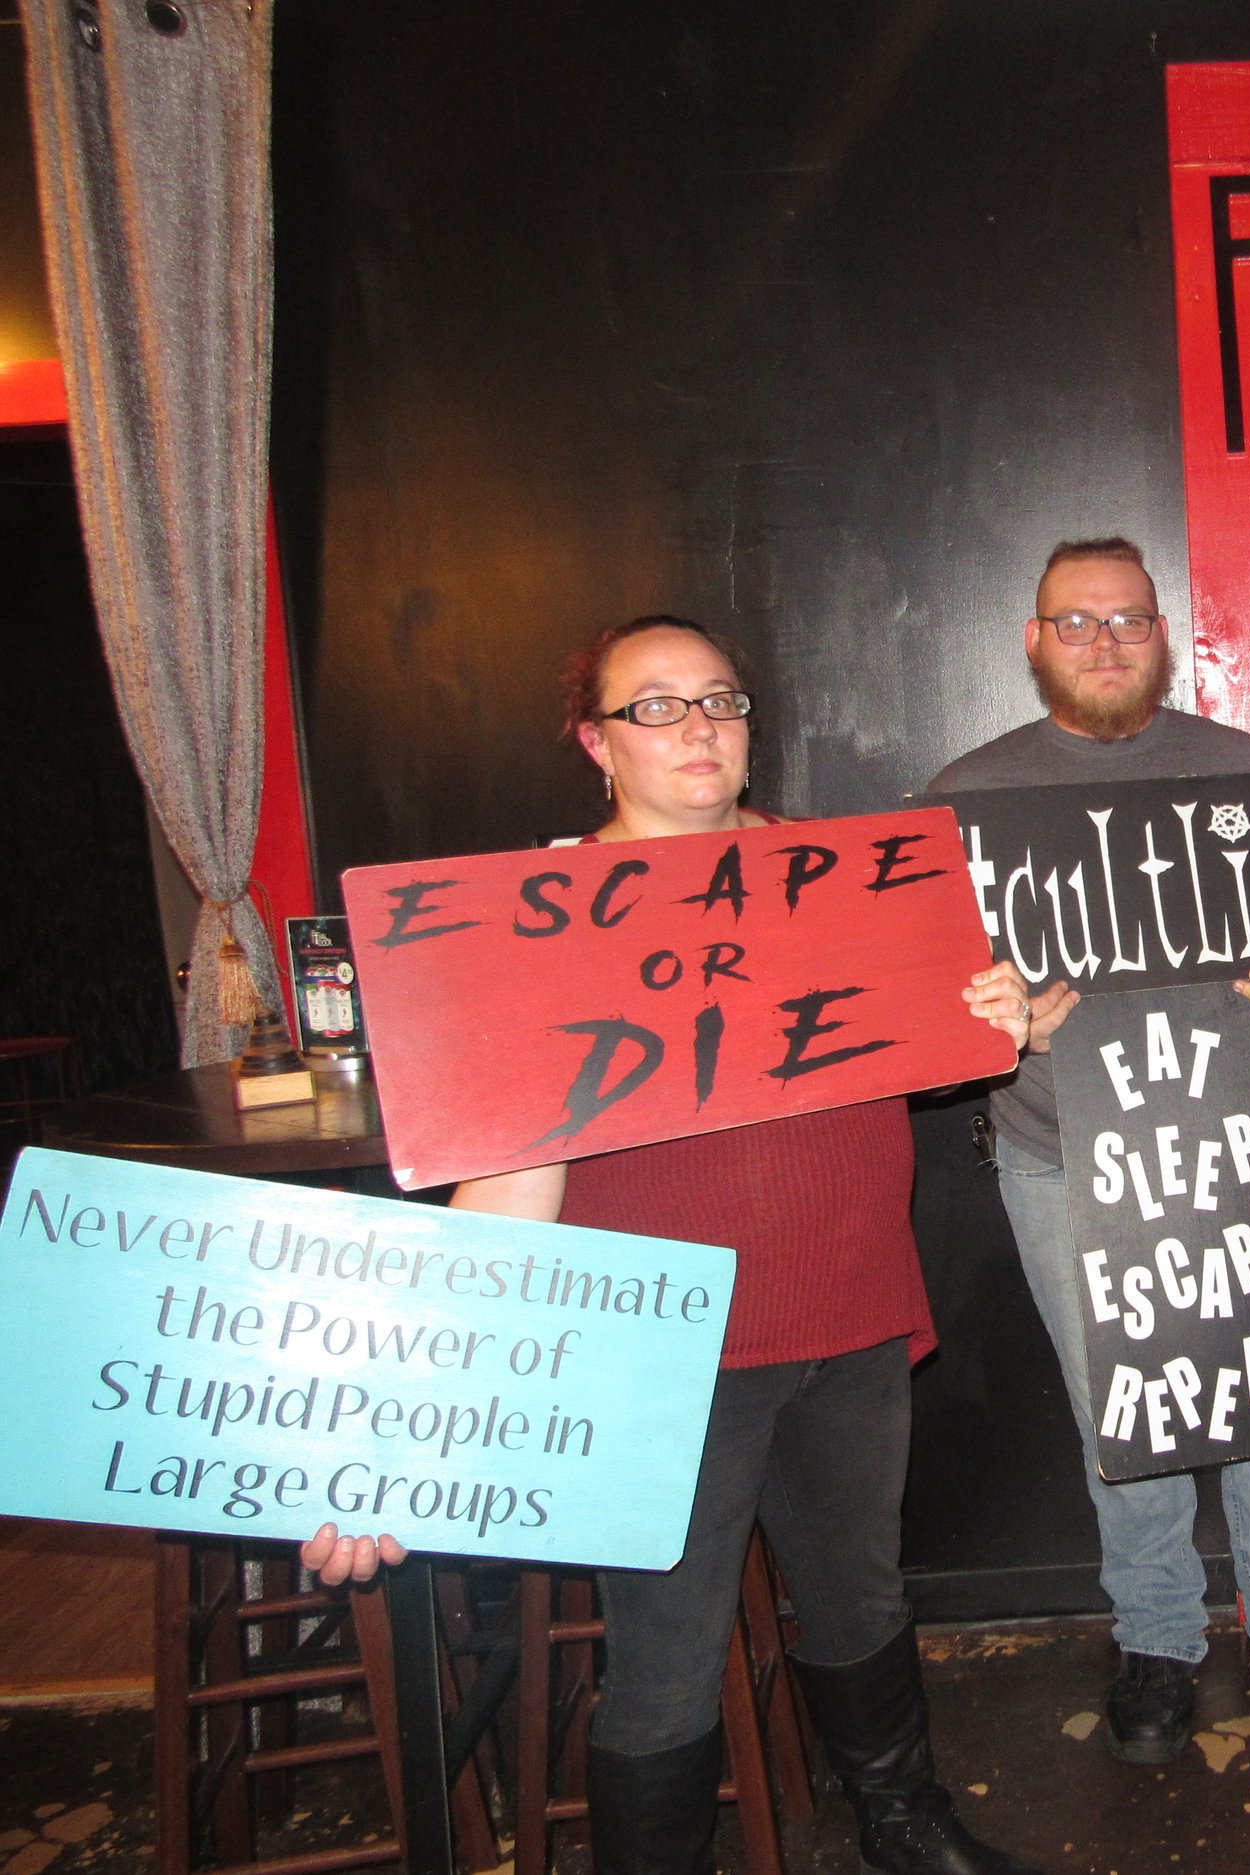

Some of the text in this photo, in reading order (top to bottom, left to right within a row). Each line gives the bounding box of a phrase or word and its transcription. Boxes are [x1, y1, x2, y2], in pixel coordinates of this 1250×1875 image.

[371, 834, 955, 953] ESCAPE
[639, 941, 755, 992] OR
[508, 986, 909, 1158] DIE
[1100, 1011, 1221, 1112] EAT
[20, 1189, 711, 1325] Never Underestimate
[155, 1285, 581, 1380] the Power of
[92, 1360, 595, 1458] Stupid People in
[104, 1440, 553, 1538] Large Groups
